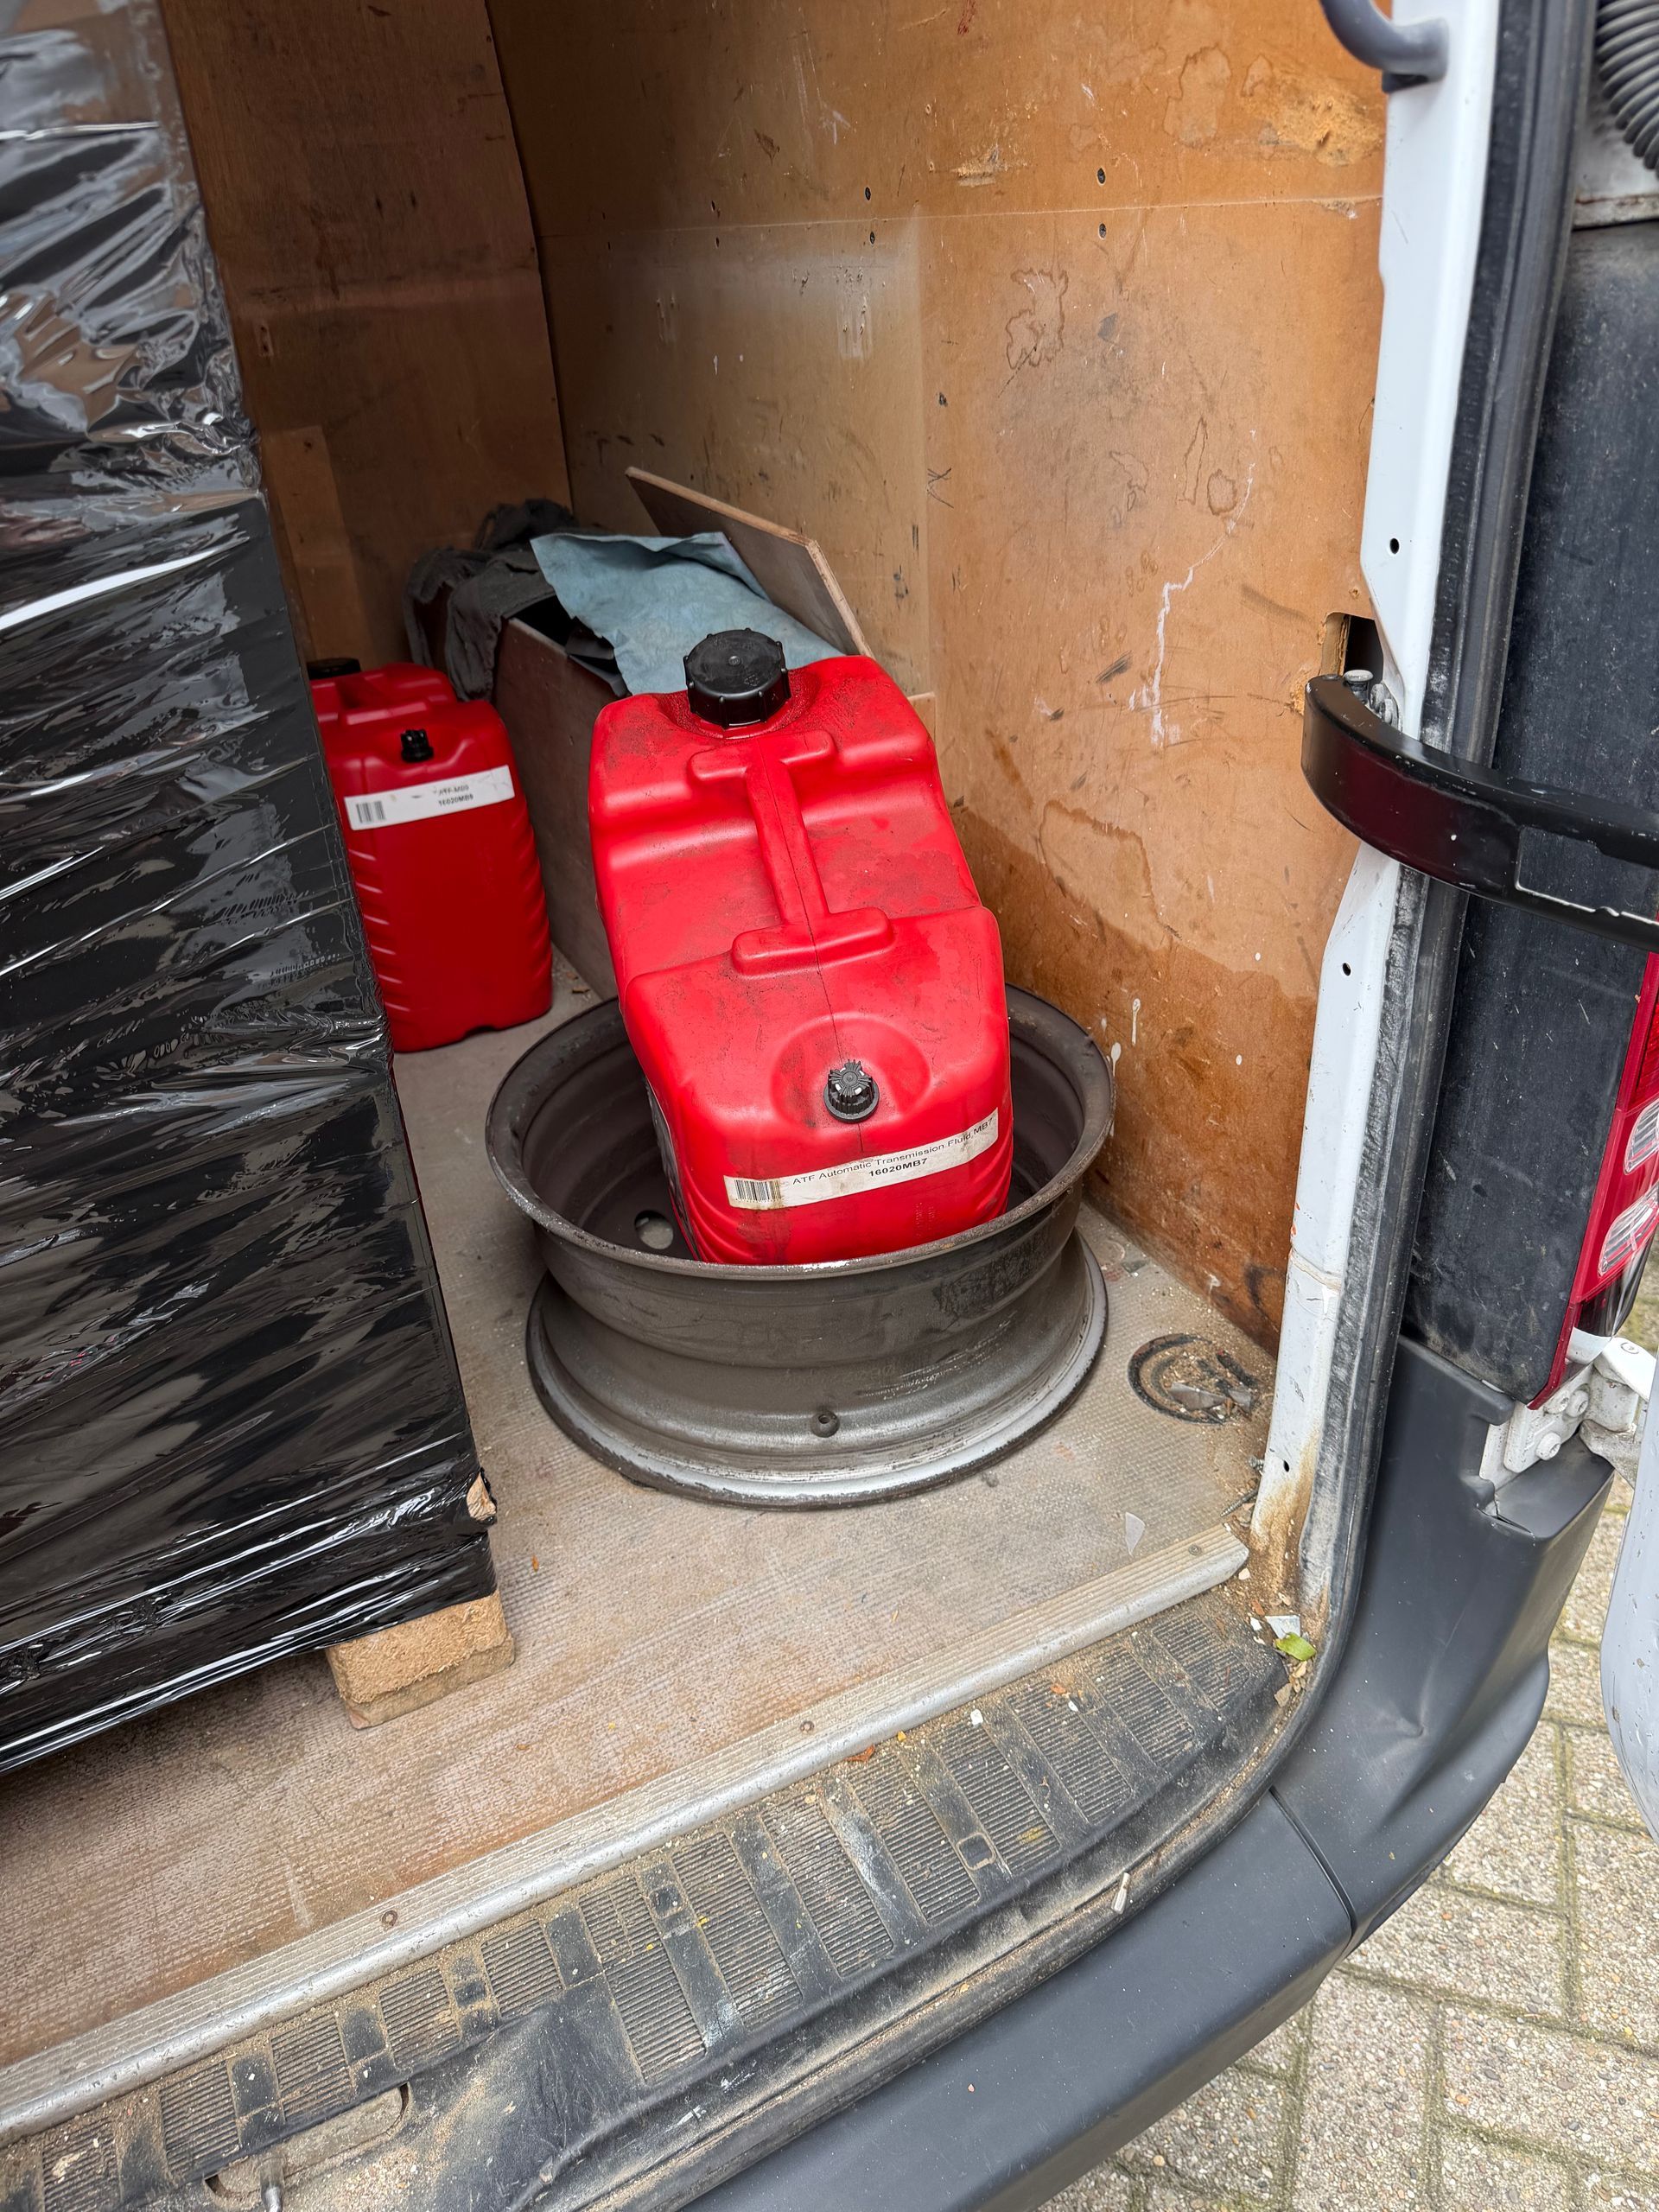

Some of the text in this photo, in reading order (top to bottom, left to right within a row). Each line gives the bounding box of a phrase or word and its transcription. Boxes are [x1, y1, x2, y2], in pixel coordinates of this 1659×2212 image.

[792, 1174, 815, 1185] ATF
[818, 1162, 872, 1179] Automatic
[874, 1144, 944, 1166] Transmission
[973, 1117, 993, 1135] MB7
[868, 1158, 927, 1177] 16020MB7
